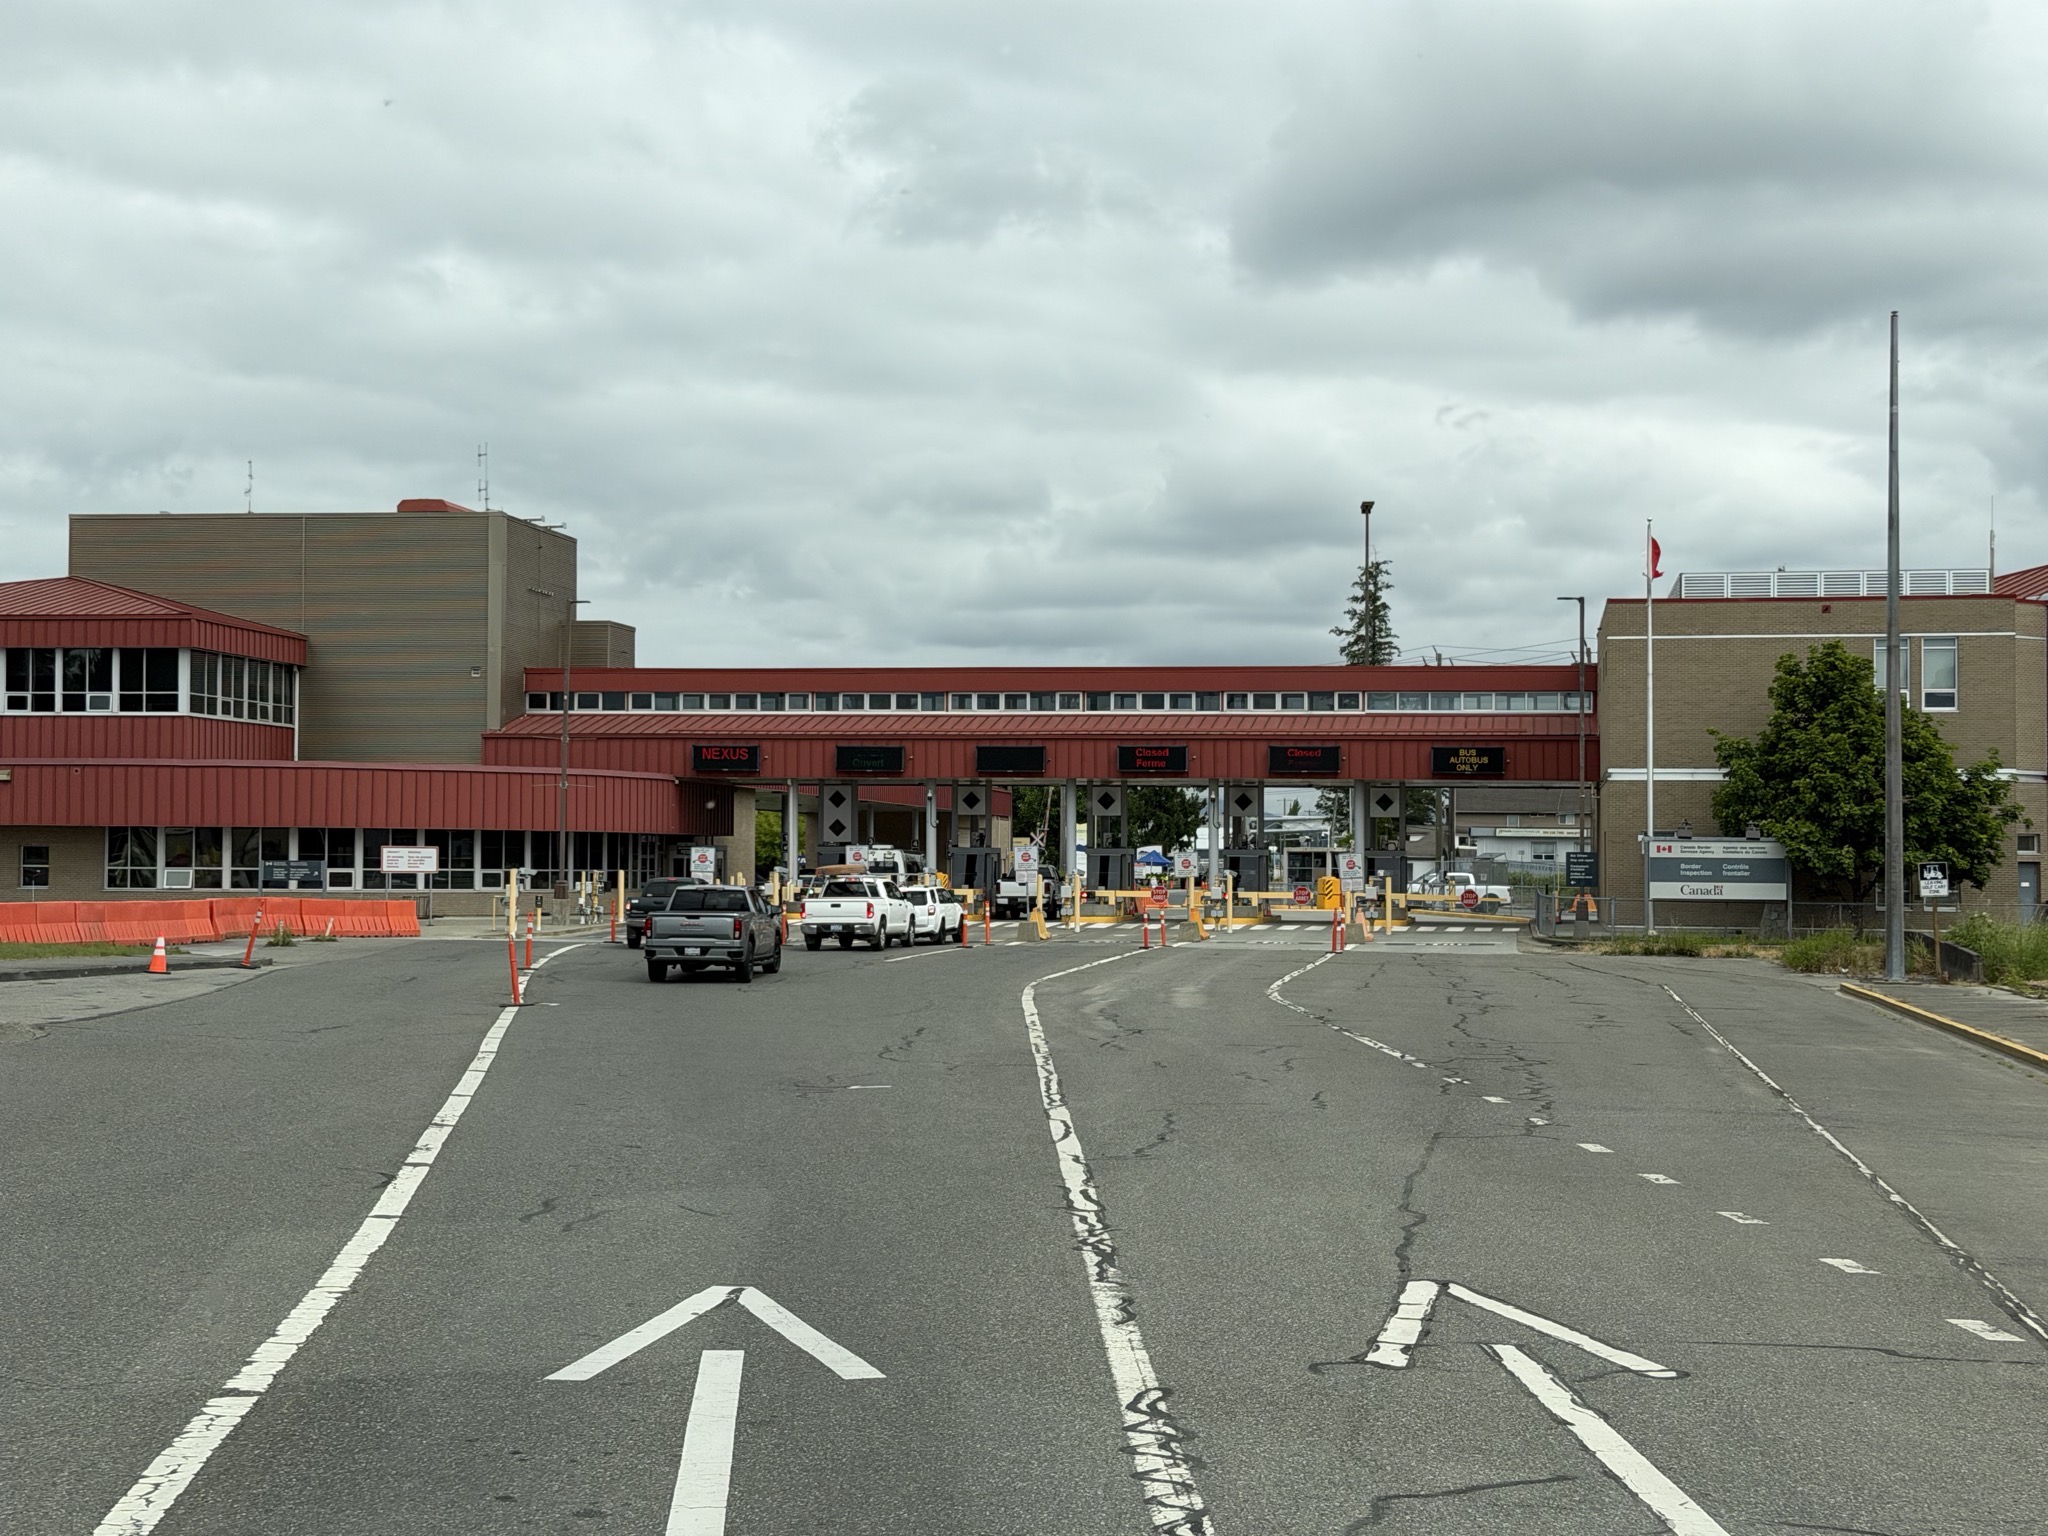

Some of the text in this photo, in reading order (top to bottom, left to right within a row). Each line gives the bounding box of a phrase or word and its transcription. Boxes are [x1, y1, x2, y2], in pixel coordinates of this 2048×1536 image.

[702, 747, 749, 760] NEXUS
[1135, 748, 1169, 757] Closed
[1287, 748, 1321, 757] Closed
[1449, 756, 1488, 764] AUTOBUS
[1680, 884, 1724, 896] Canada
